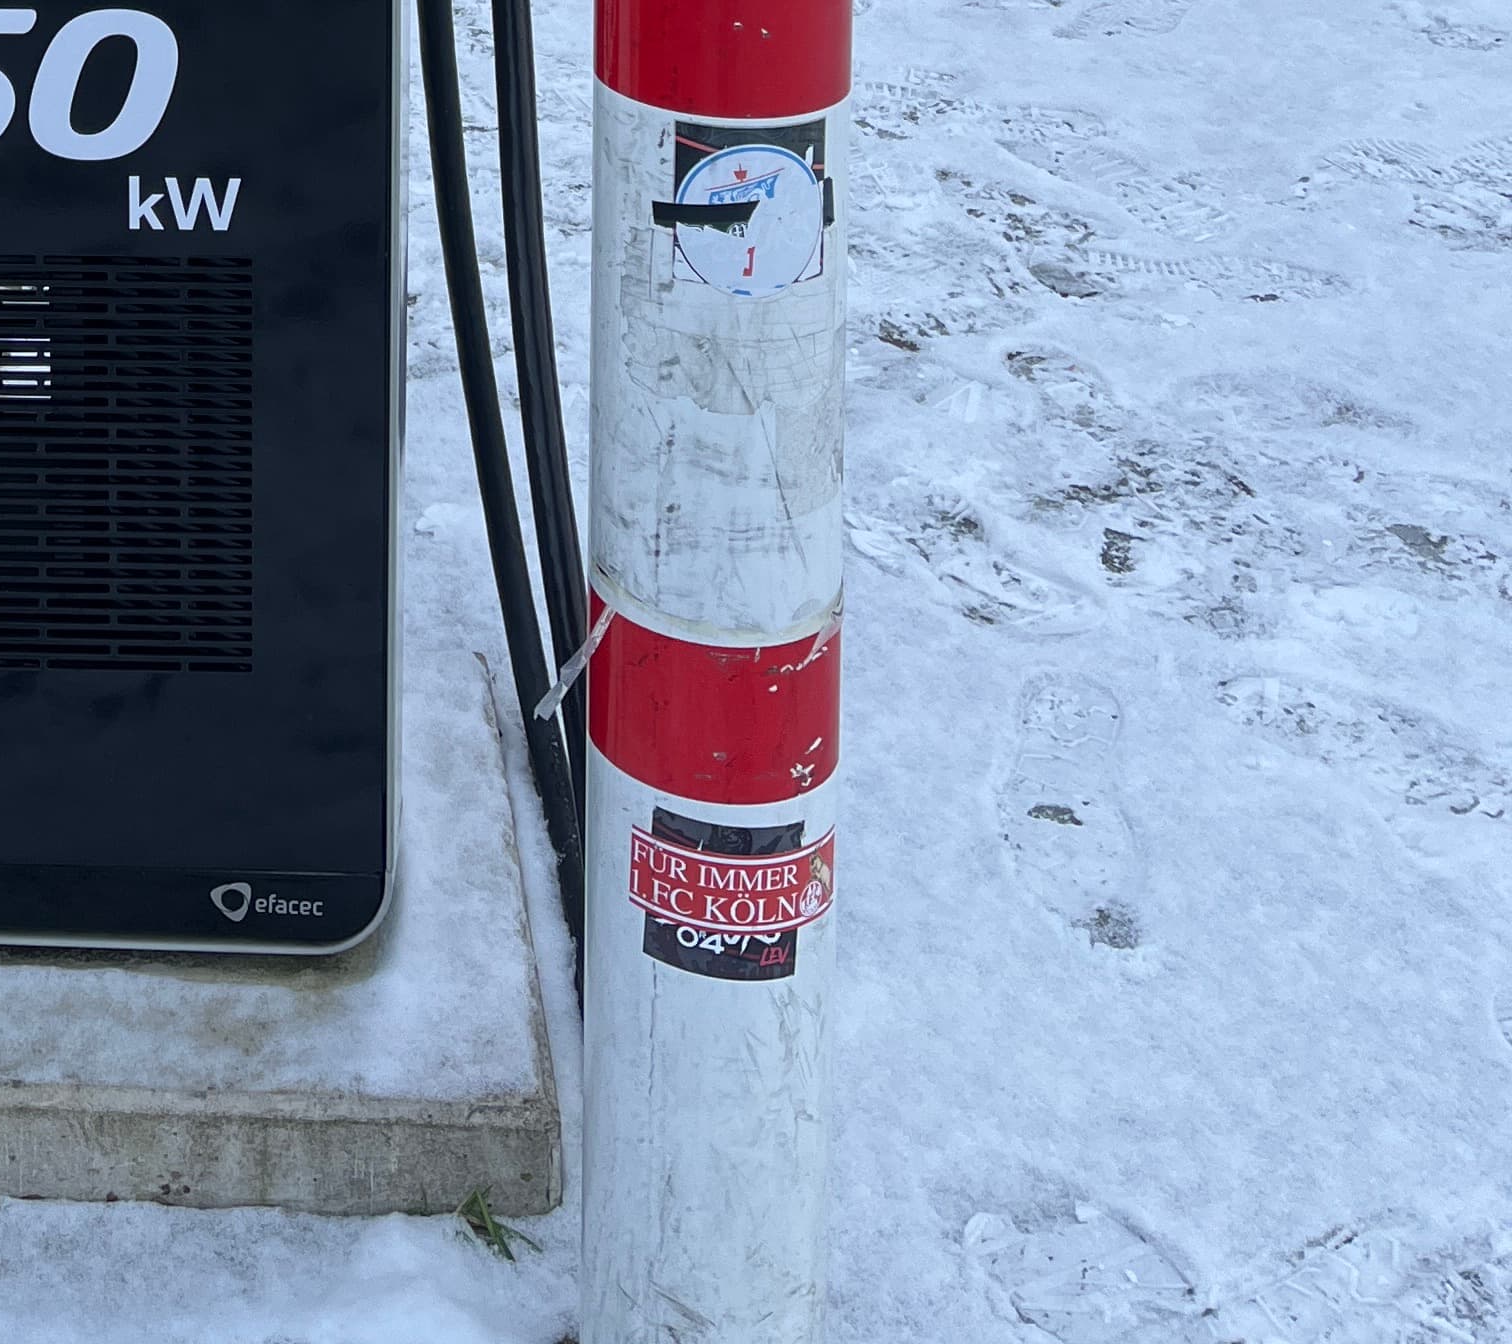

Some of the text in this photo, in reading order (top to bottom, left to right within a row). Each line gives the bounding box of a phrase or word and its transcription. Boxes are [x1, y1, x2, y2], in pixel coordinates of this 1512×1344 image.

[128, 175, 243, 231] kW
[633, 838, 798, 892] FÜR IMMER
[254, 893, 324, 917] efacec
[703, 892, 799, 924] KÖLN
